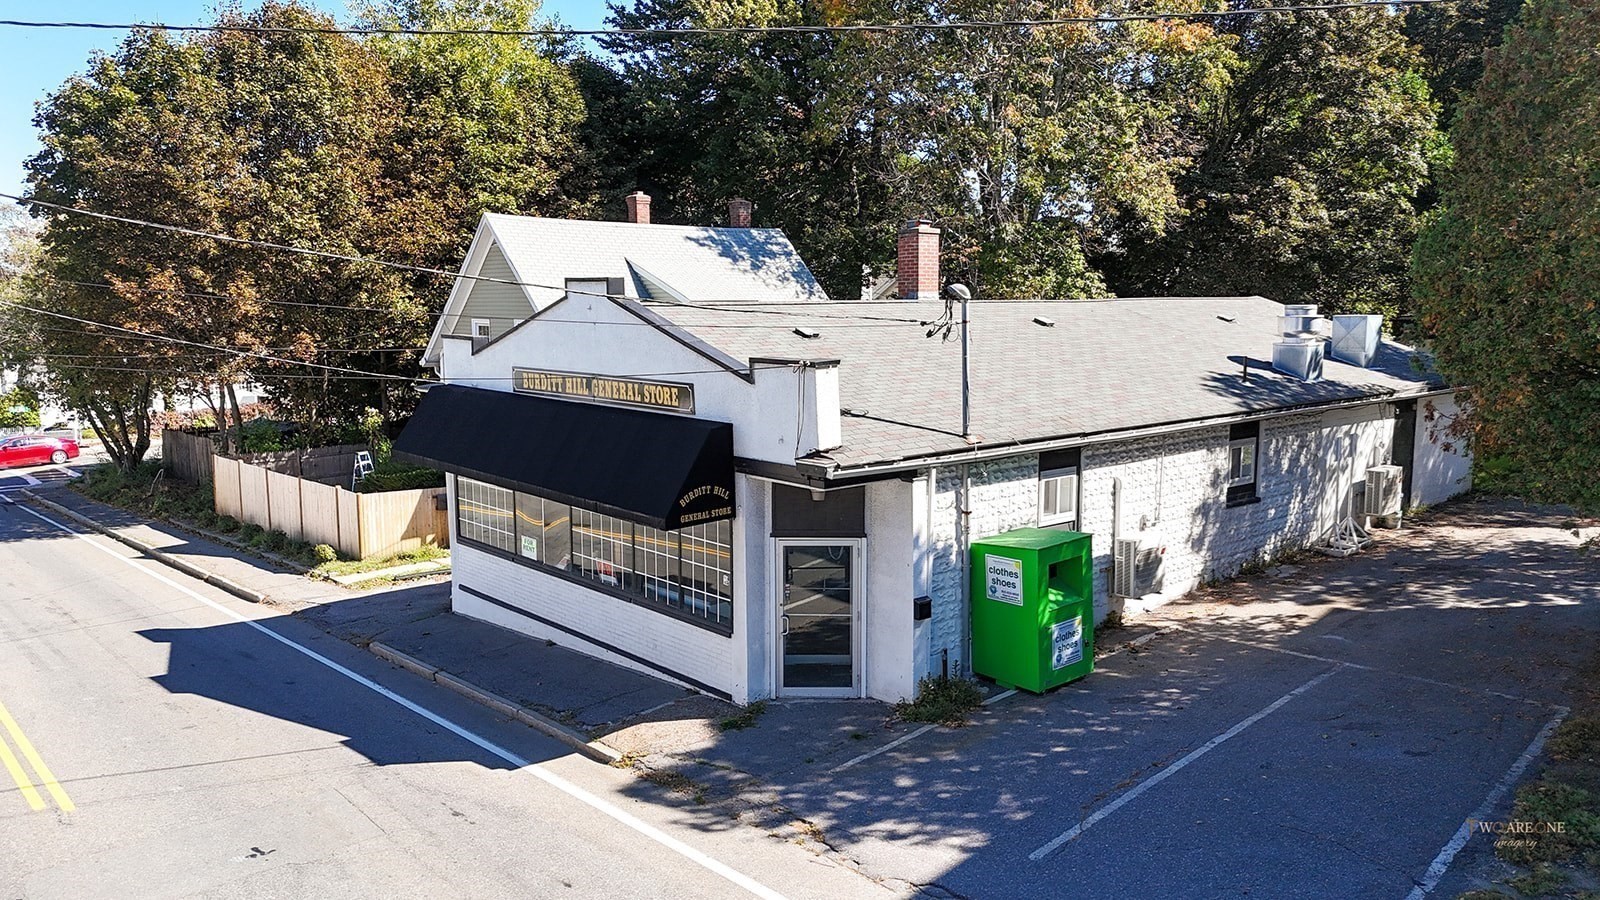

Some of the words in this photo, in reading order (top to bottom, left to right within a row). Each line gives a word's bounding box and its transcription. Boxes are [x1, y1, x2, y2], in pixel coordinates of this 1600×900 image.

[522, 372, 563, 392] BURDITT
[565, 377, 589, 396] HILL
[591, 379, 642, 402] GENERAL
[644, 385, 680, 407] STORE
[679, 485, 712, 508] BURDITT
[713, 485, 730, 500] HILL
[680, 510, 710, 524] GENERAL
[711, 506, 732, 518] STORE
[988, 566, 1019, 579] clothes
[991, 577, 1017, 589] shoes
[1055, 629, 1080, 643] clothes
[1057, 640, 1078, 653] shoes
